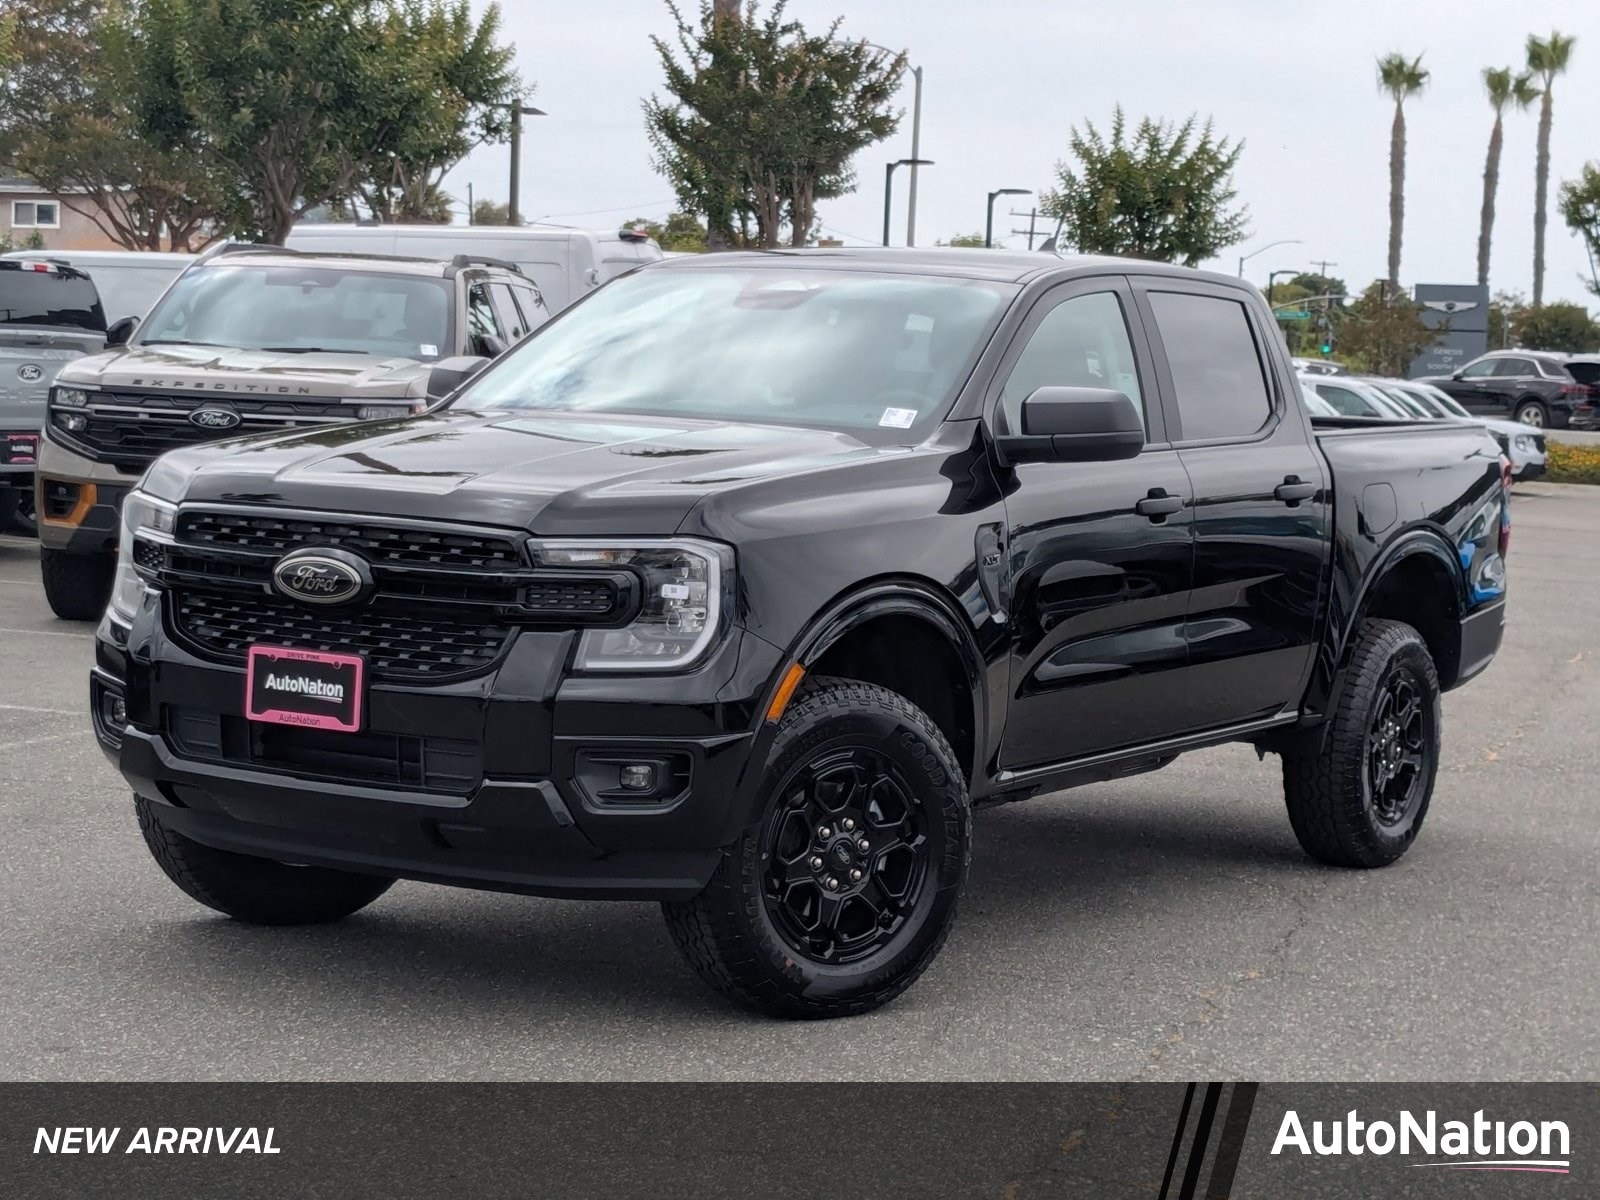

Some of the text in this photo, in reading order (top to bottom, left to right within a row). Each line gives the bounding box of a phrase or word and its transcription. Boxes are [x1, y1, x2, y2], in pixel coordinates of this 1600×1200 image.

[132, 379, 310, 394] EXPEDITION
[200, 411, 229, 426] Ford
[292, 565, 339, 592] Ford
[264, 673, 344, 698] AutoNation
[278, 713, 321, 727] AutoNation
